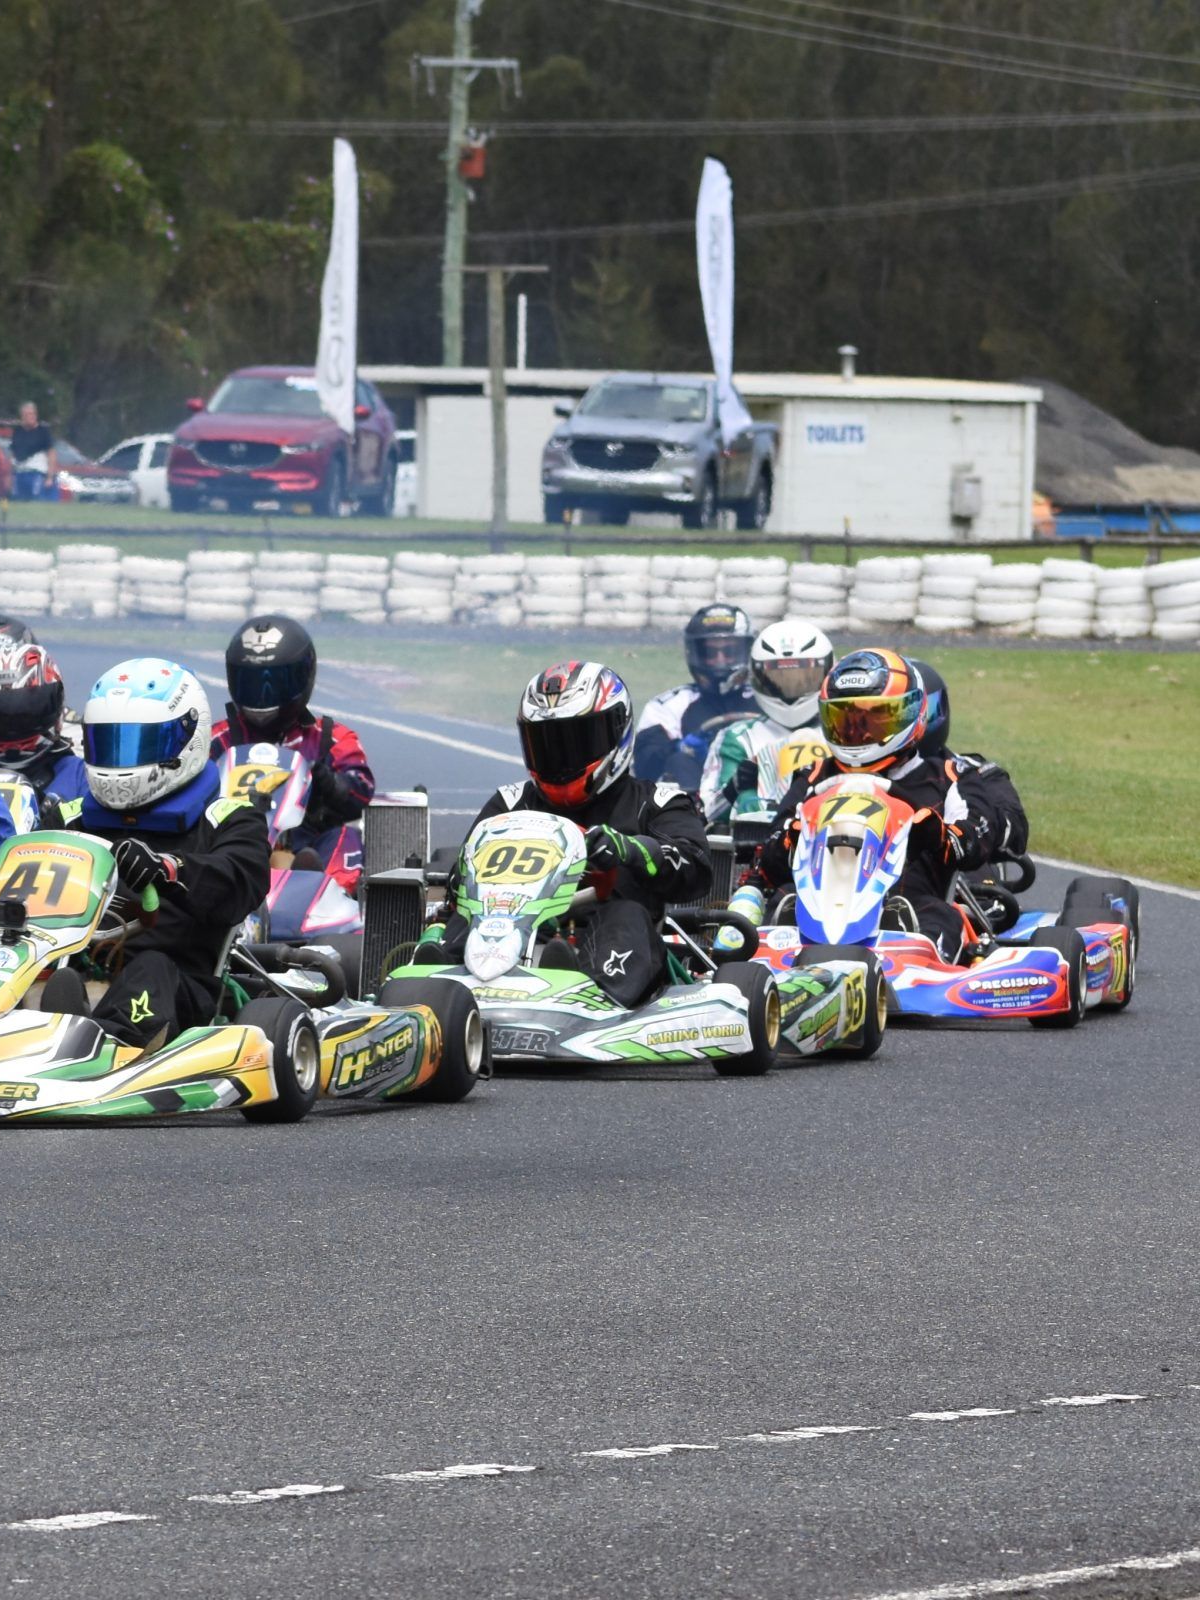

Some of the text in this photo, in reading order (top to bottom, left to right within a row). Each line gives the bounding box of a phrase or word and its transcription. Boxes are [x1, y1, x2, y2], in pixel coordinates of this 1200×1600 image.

[807, 426, 864, 443] TOILETS
[840, 677, 866, 686] SHOEI
[789, 744, 828, 765] 79
[822, 796, 885, 824] 77
[481, 846, 550, 878] 95
[967, 976, 1049, 991] PRECISION
[647, 1023, 745, 1046] KARTING WORLD
[337, 1026, 414, 1087] HUNTER
